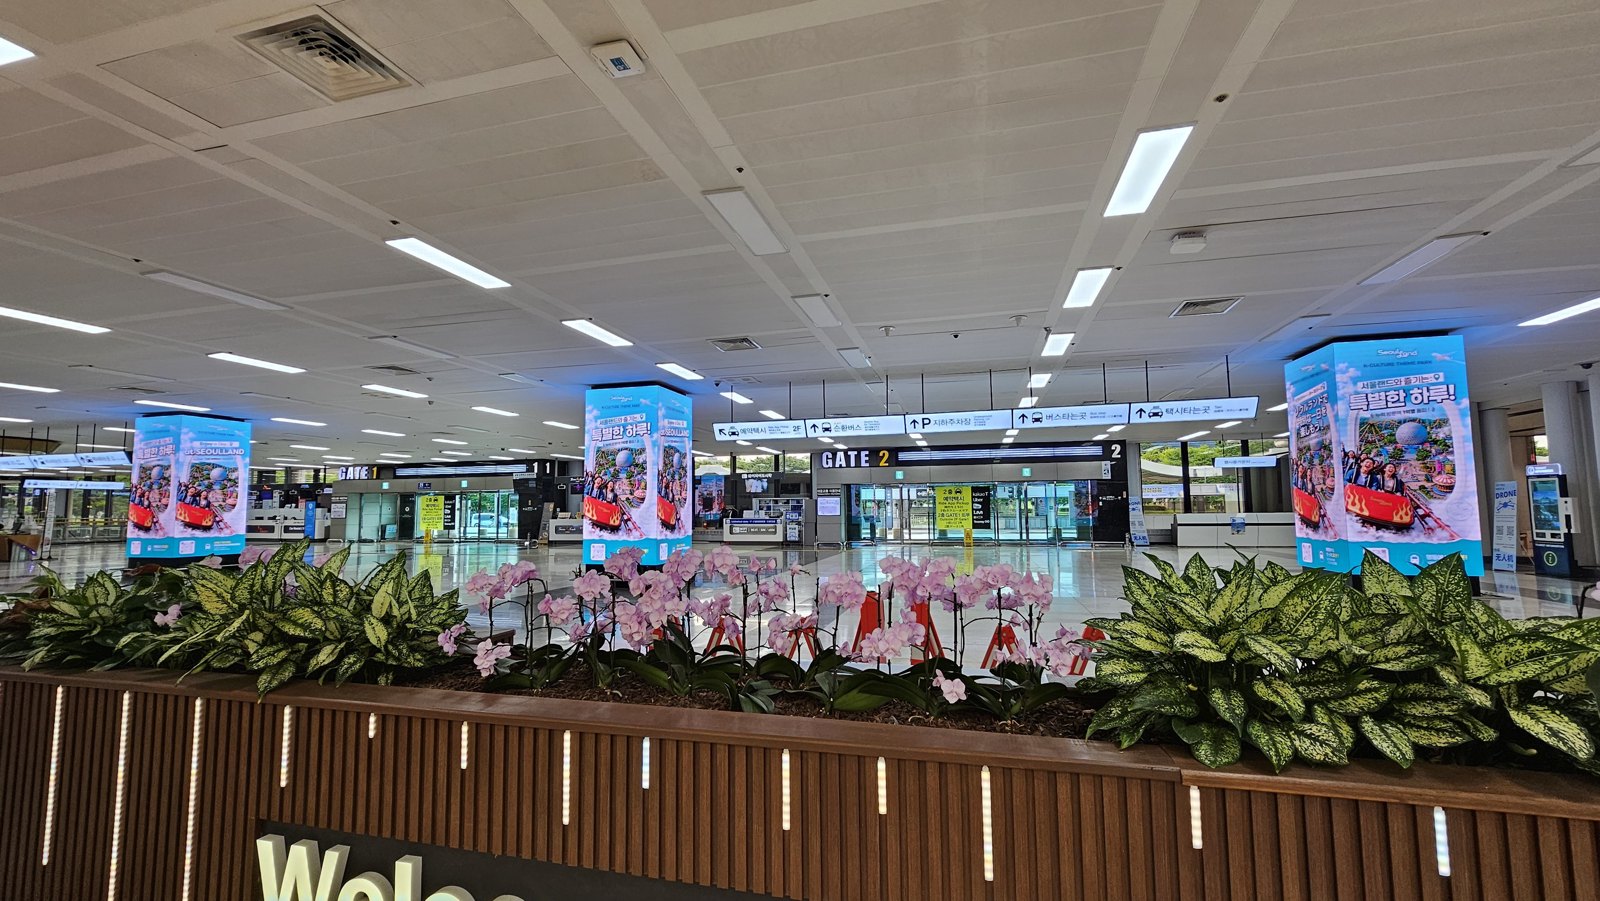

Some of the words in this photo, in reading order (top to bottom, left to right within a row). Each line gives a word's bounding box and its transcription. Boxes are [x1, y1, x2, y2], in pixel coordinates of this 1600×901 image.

[1361, 379, 1402, 389] 서울랜드와
[1349, 389, 1407, 411] 특별한
[1409, 384, 1456, 405] 하루!
[1046, 412, 1087, 421] 버스타는곳
[1165, 406, 1210, 415] 택시타는곳
[933, 418, 971, 427] 지하주차장
[592, 425, 624, 442] 특별한
[625, 422, 651, 437] 하루!
[1111, 444, 1121, 458] 2
[821, 450, 869, 468] GATE
[879, 450, 889, 467] 2
[338, 466, 368, 480] GATE
[372, 466, 377, 479] 1
[533, 462, 538, 474] 1
[545, 462, 550, 474] 1
[1495, 489, 1517, 499] DRONE
[1495, 553, 1514, 563] 无人机
